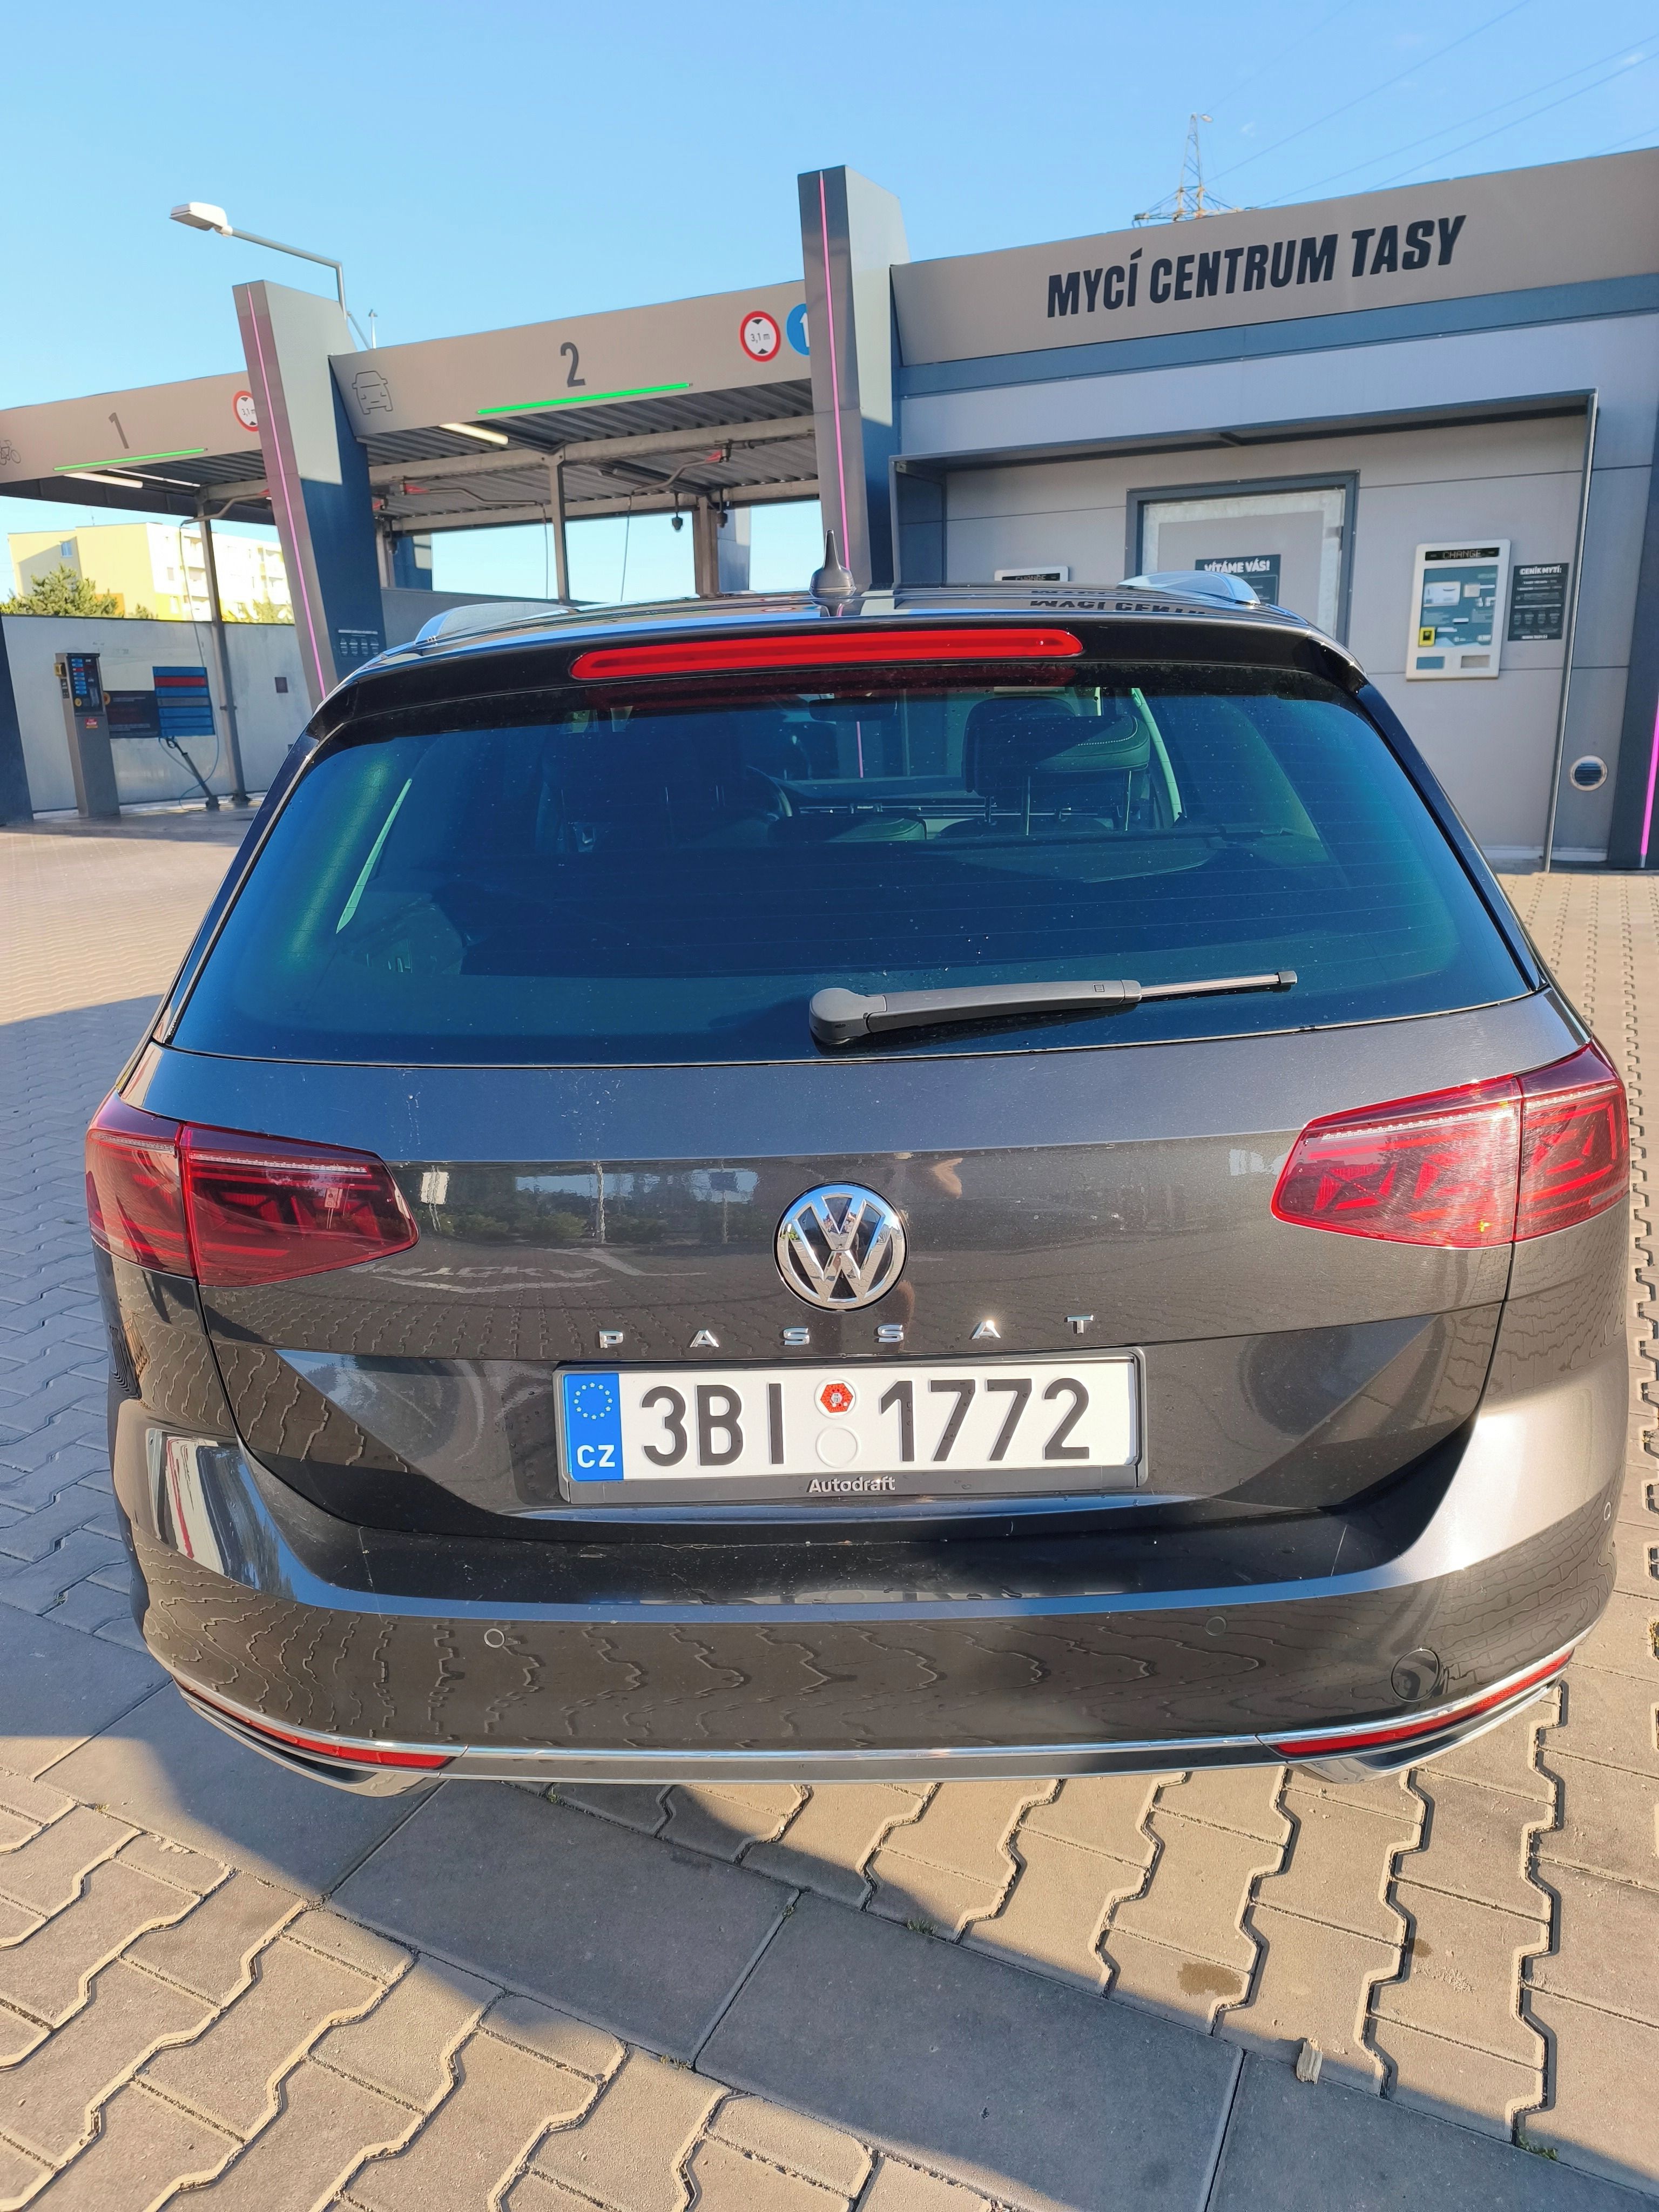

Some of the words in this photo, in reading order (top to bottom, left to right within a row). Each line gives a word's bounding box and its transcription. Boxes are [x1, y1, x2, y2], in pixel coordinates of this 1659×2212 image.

[1048, 247, 1143, 318] MYCÍ
[1150, 234, 1339, 304] CENTRUM
[1351, 215, 1467, 277] TASY
[750, 333, 761, 343] 3,1
[559, 341, 586, 388] 2
[108, 412, 130, 449] 1
[1204, 560, 1244, 574] VÍTÁME
[1245, 558, 1270, 572] VÁS!
[1442, 550, 1482, 559] CHANGE
[598, 1314, 1094, 1349] PASSAT
[642, 1384, 784, 1467] 3BI
[881, 1378, 1090, 1462] 1772
[576, 1444, 616, 1468] CZ
[808, 1475, 896, 1493] Autodraft
